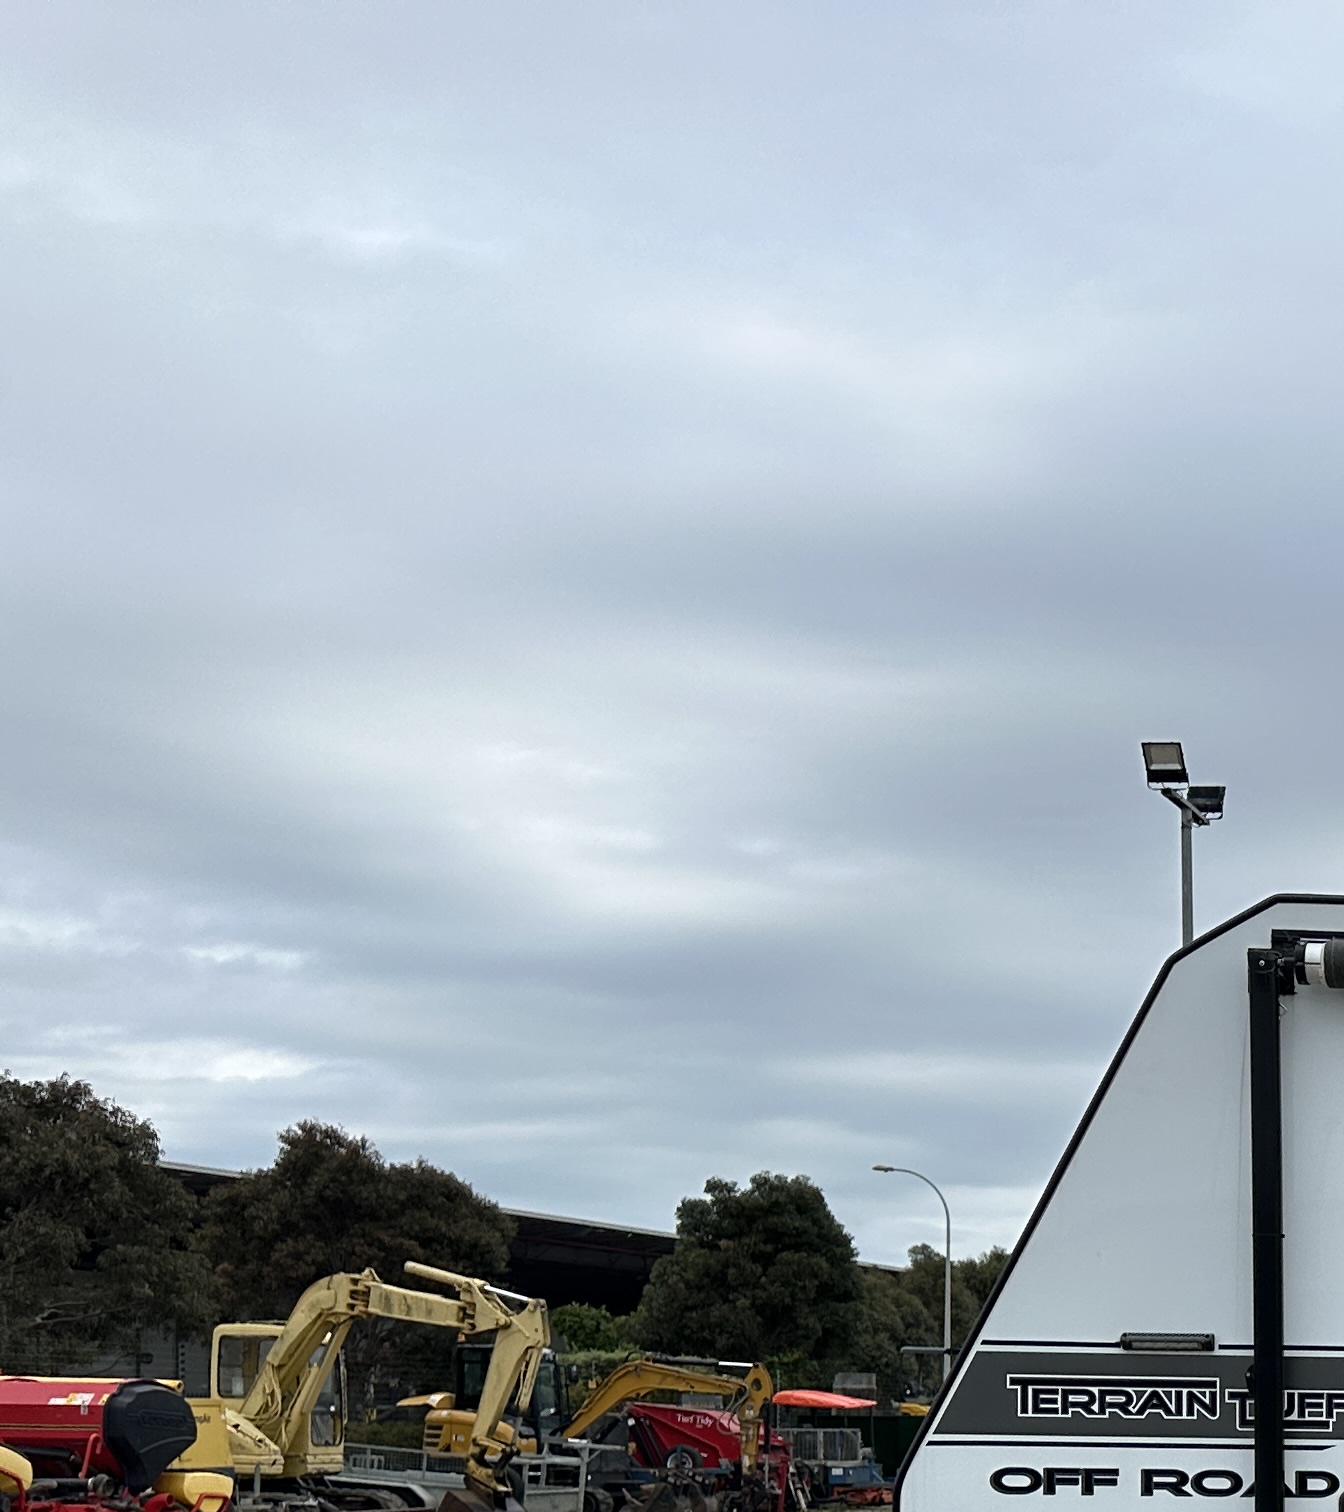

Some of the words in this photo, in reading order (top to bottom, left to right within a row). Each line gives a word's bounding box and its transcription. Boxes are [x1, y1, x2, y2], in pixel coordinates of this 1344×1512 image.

[1006, 1373, 1220, 1420] TERRAIN
[677, 1414, 695, 1423] Turf
[696, 1416, 713, 1427] Tidy
[989, 1466, 1120, 1496] OFF
